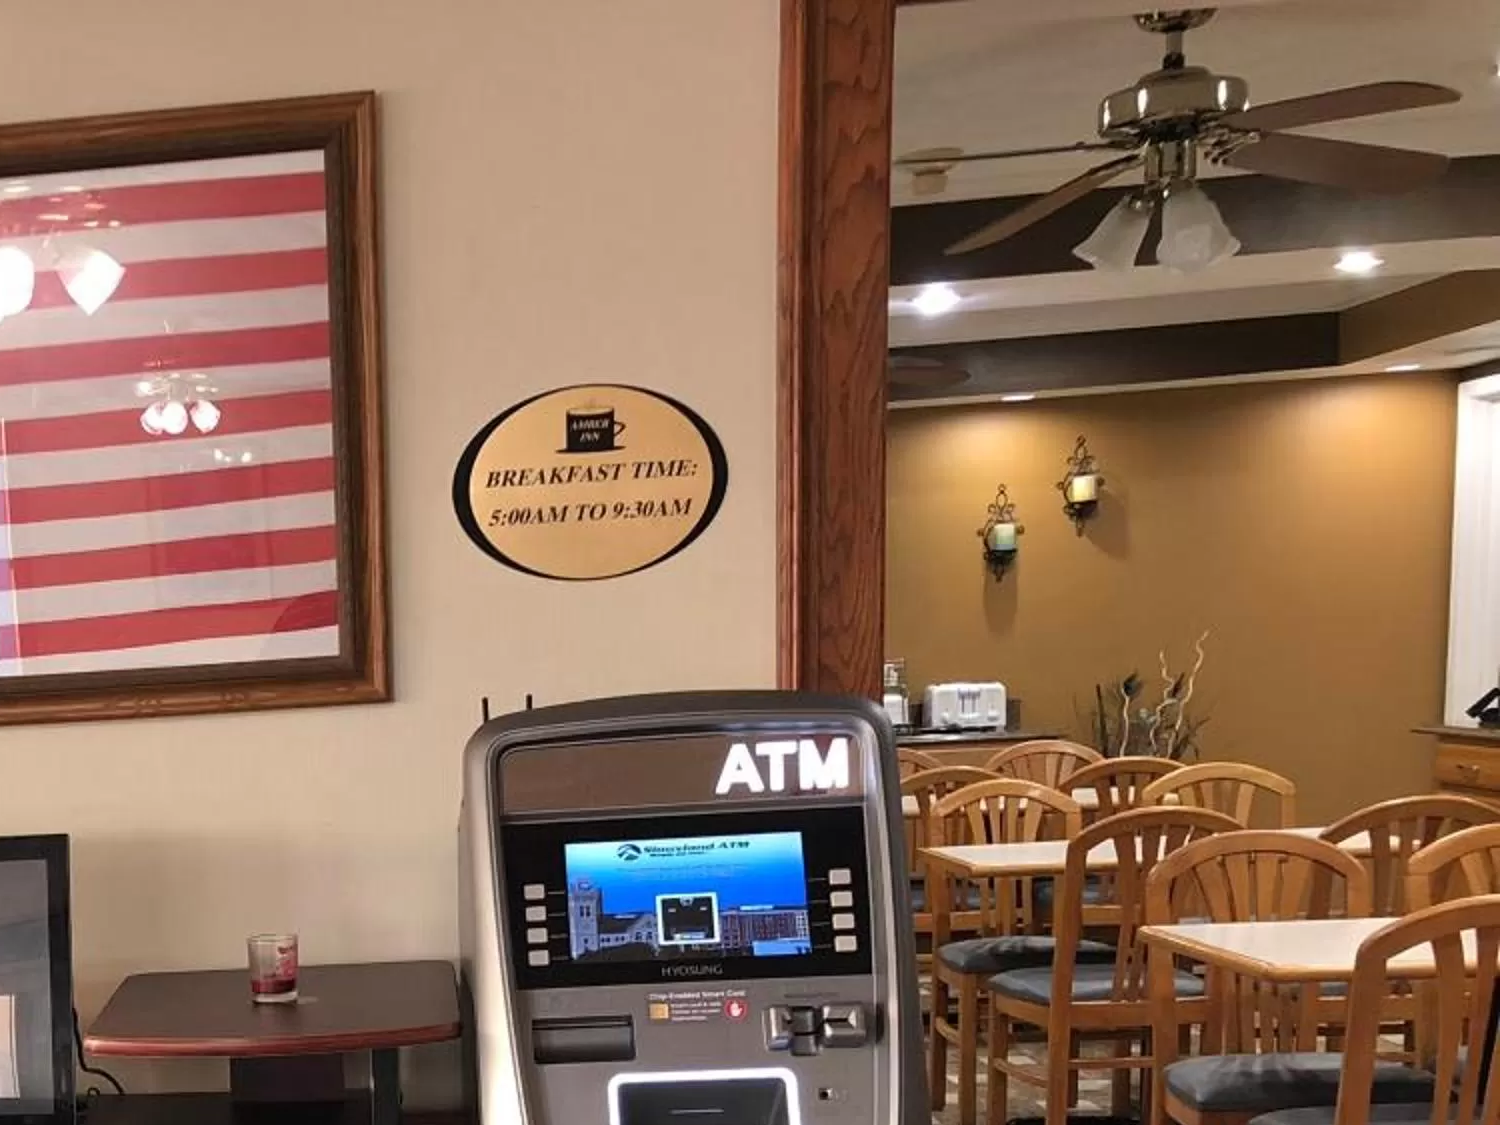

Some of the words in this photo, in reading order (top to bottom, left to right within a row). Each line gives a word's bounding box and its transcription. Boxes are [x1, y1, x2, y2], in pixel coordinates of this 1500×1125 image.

[580, 432, 601, 442] INN
[485, 462, 627, 489] BREAKFAST
[631, 458, 699, 480] TIME:
[488, 506, 569, 527] 5:00AM
[575, 503, 607, 521] TO
[612, 498, 693, 519] 9:30AM
[715, 737, 849, 795] ATM
